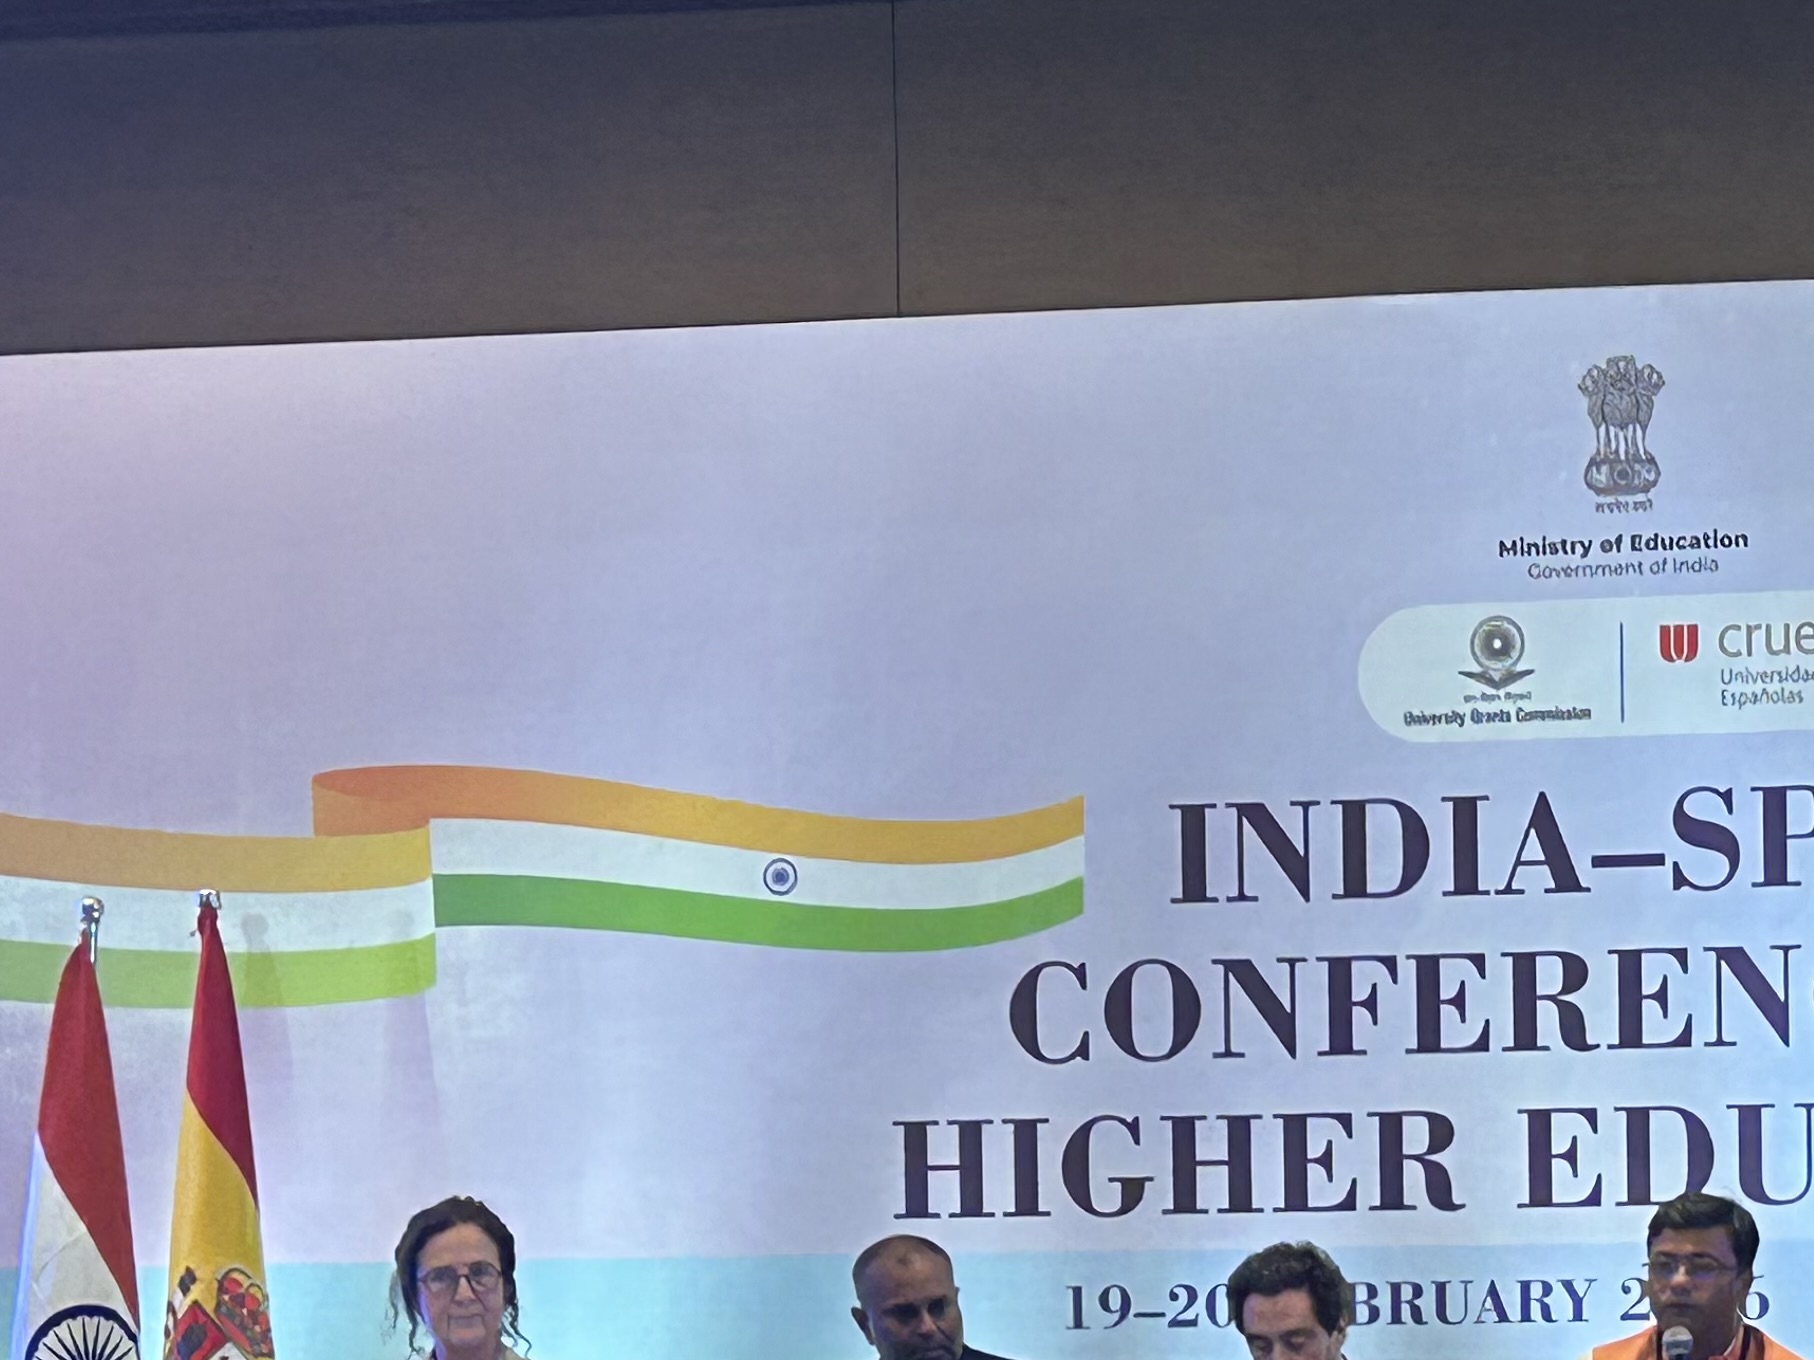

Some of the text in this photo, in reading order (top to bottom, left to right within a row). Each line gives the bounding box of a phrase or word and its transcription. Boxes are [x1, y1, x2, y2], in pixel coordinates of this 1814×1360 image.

[1499, 536, 1592, 559] Ministry
[1631, 528, 1748, 552] Education
[1721, 687, 1804, 710] Españolas
[892, 1111, 1466, 1219] HIGHER
[1352, 1278, 1597, 1326] BRUARY
[1620, 1275, 1770, 1322] 26
